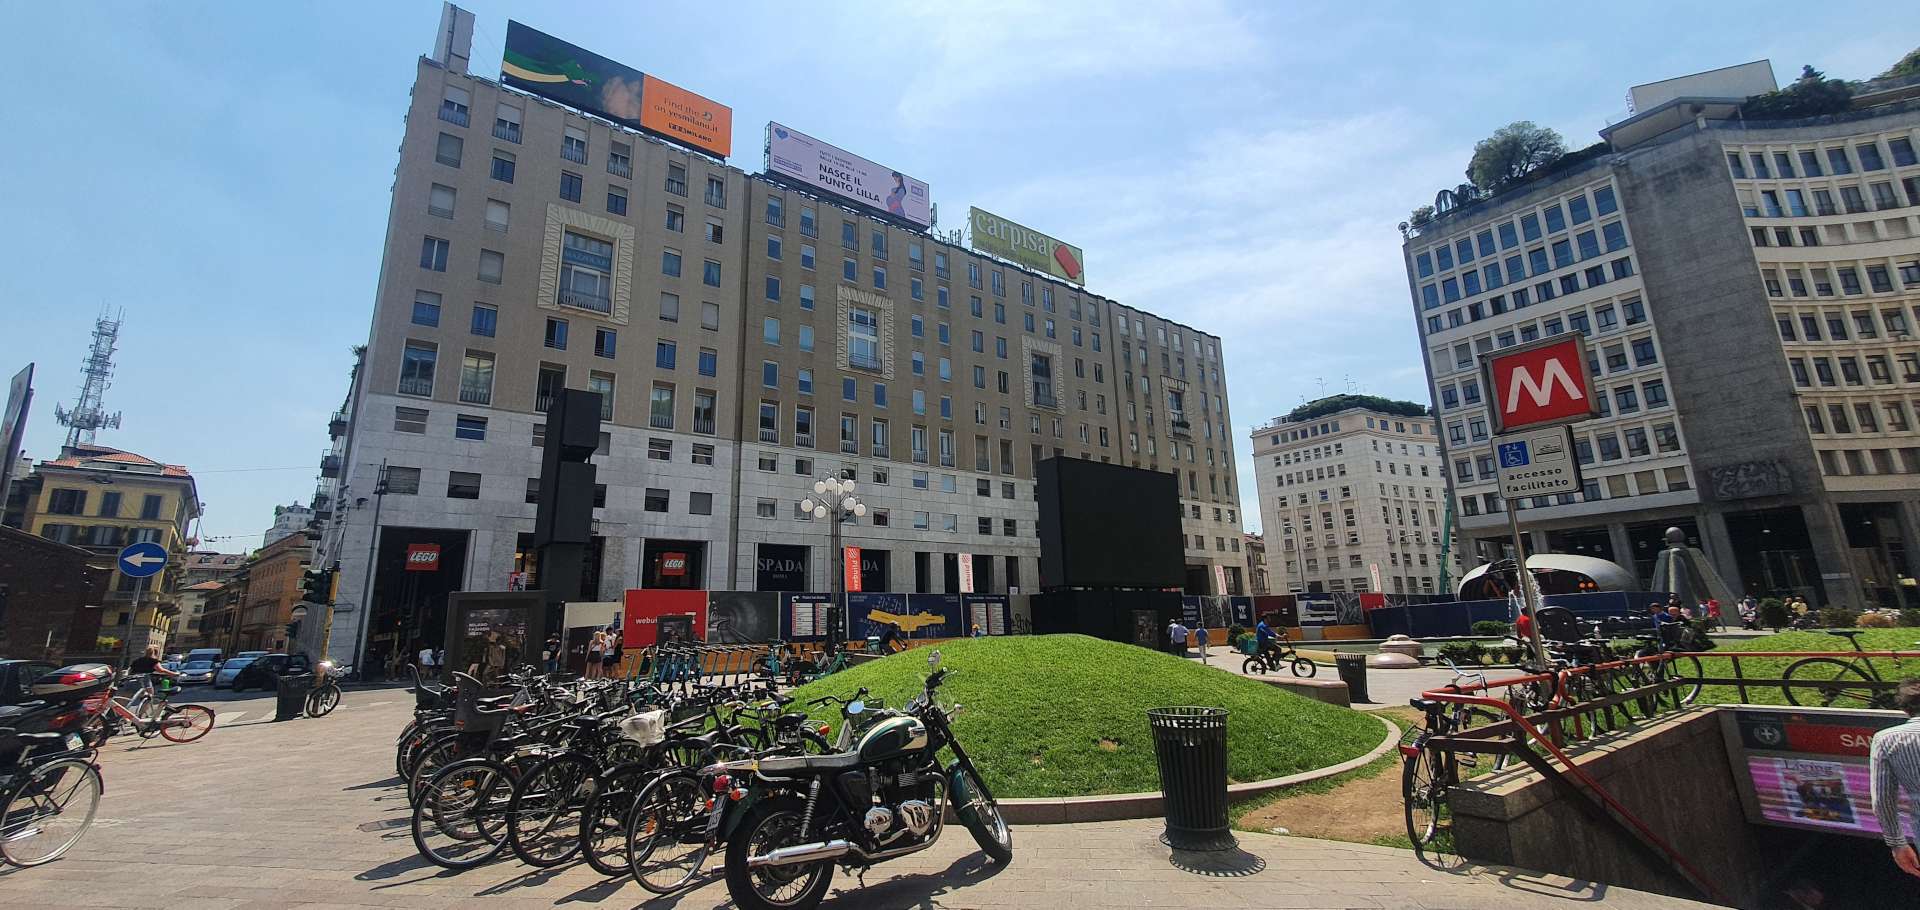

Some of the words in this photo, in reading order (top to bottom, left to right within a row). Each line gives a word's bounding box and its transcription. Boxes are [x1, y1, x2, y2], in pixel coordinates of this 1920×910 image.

[664, 96, 683, 110] Find
[667, 109, 718, 133] yesmilano.it
[819, 163, 852, 182] NASCE
[854, 176, 863, 187] IL
[819, 174, 854, 192] PUNTO
[975, 213, 1049, 257] carpisa
[1506, 358, 1584, 414] M
[1508, 468, 1563, 481] accesso
[1506, 479, 1569, 493] facilitato
[410, 551, 438, 562] LEGO
[664, 559, 685, 568] LEGO
[758, 558, 804, 573] SPADA
